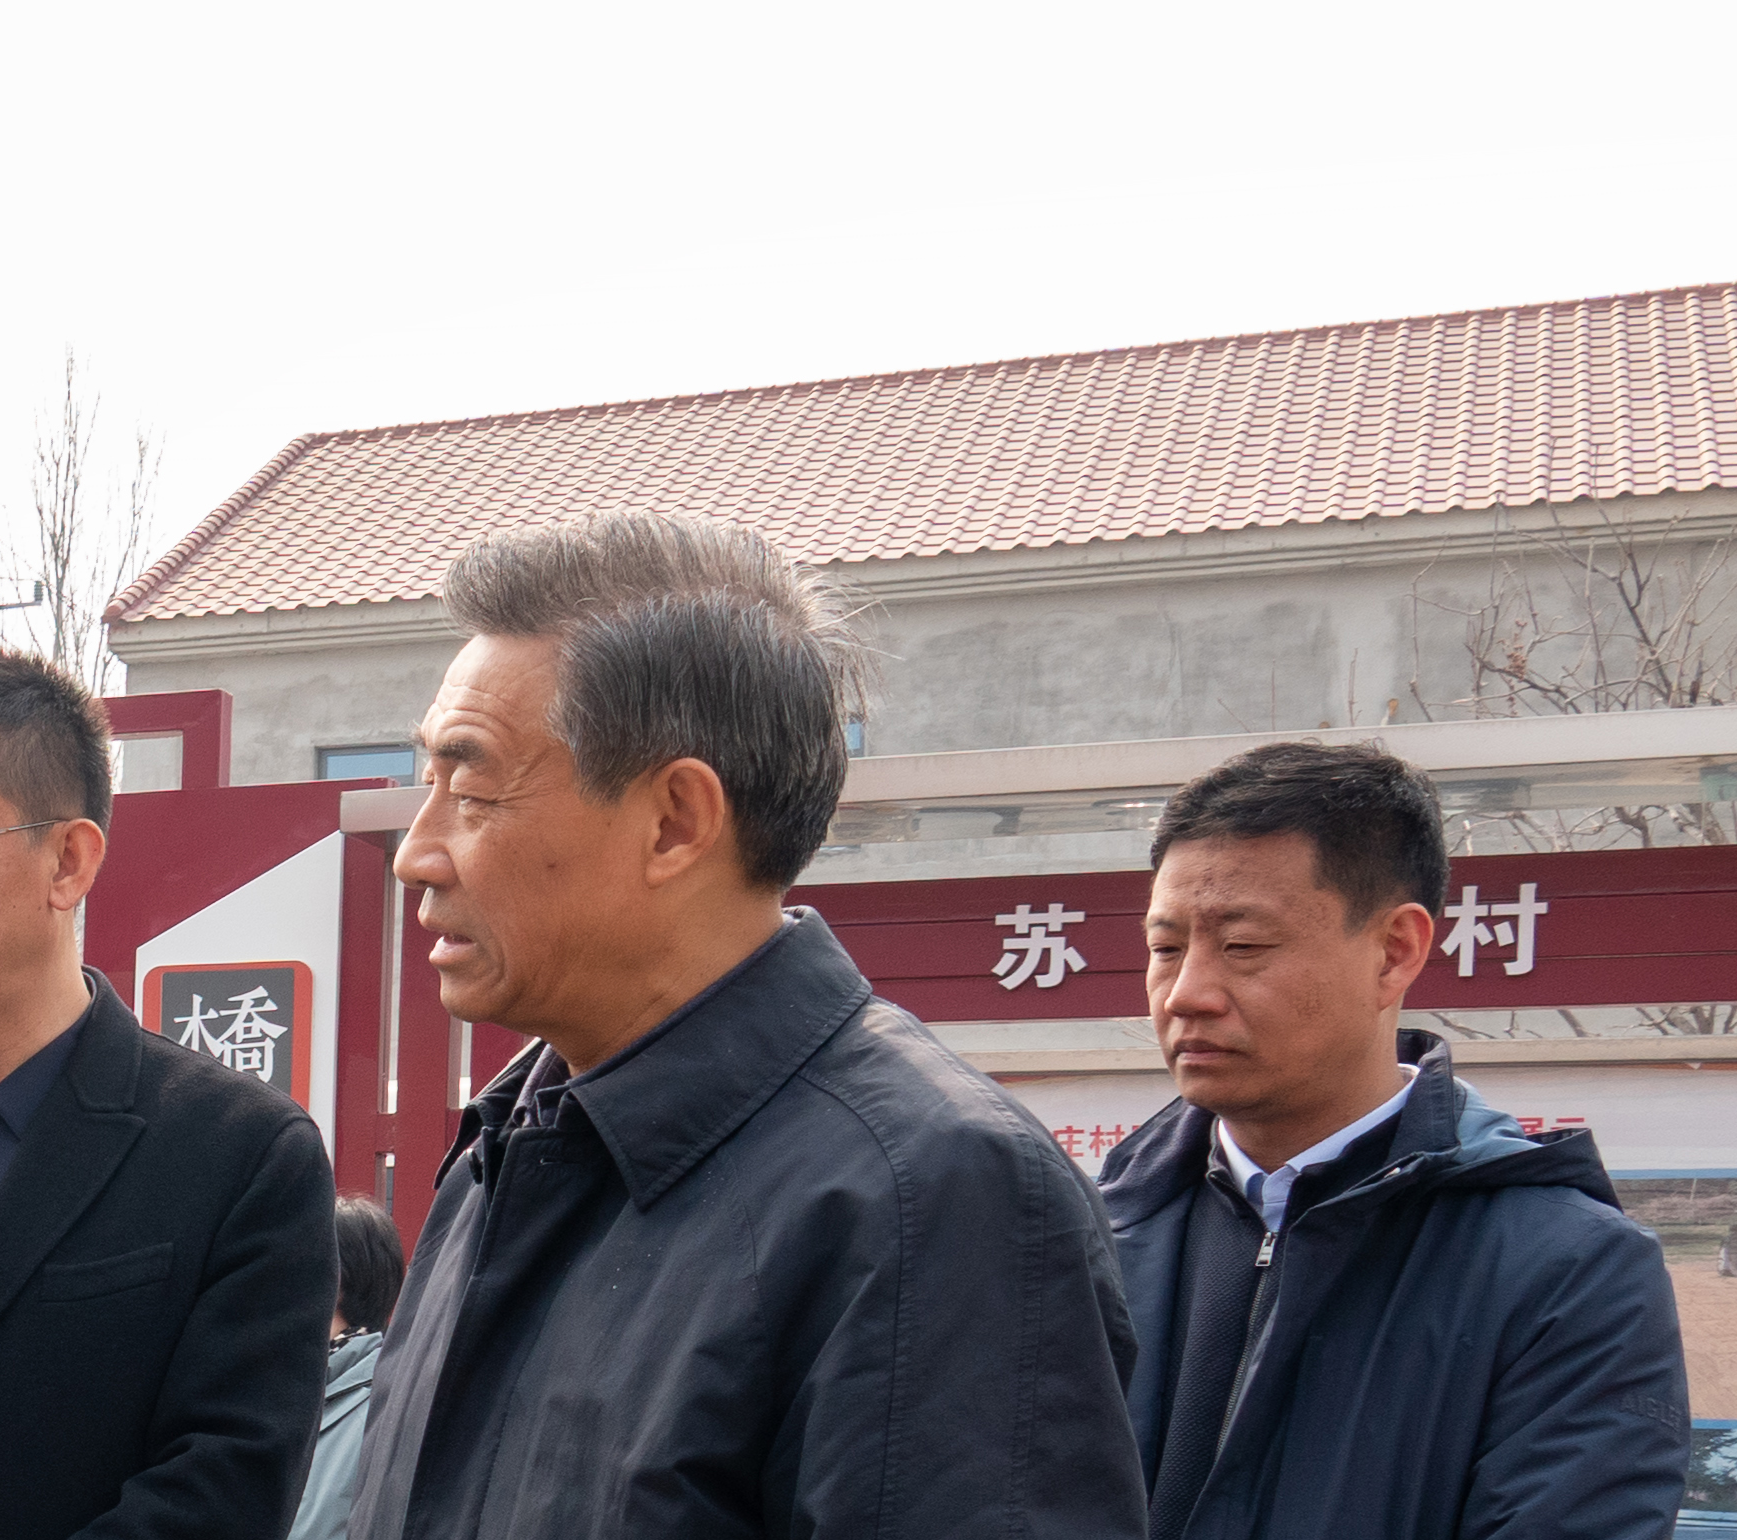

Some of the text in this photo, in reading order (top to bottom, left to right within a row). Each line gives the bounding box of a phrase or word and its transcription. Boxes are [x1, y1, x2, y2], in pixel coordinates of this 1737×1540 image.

[991, 883, 1548, 990] 苏 村
[173, 985, 289, 1084] 橋
[1052, 1123, 1142, 1159] 庄村
